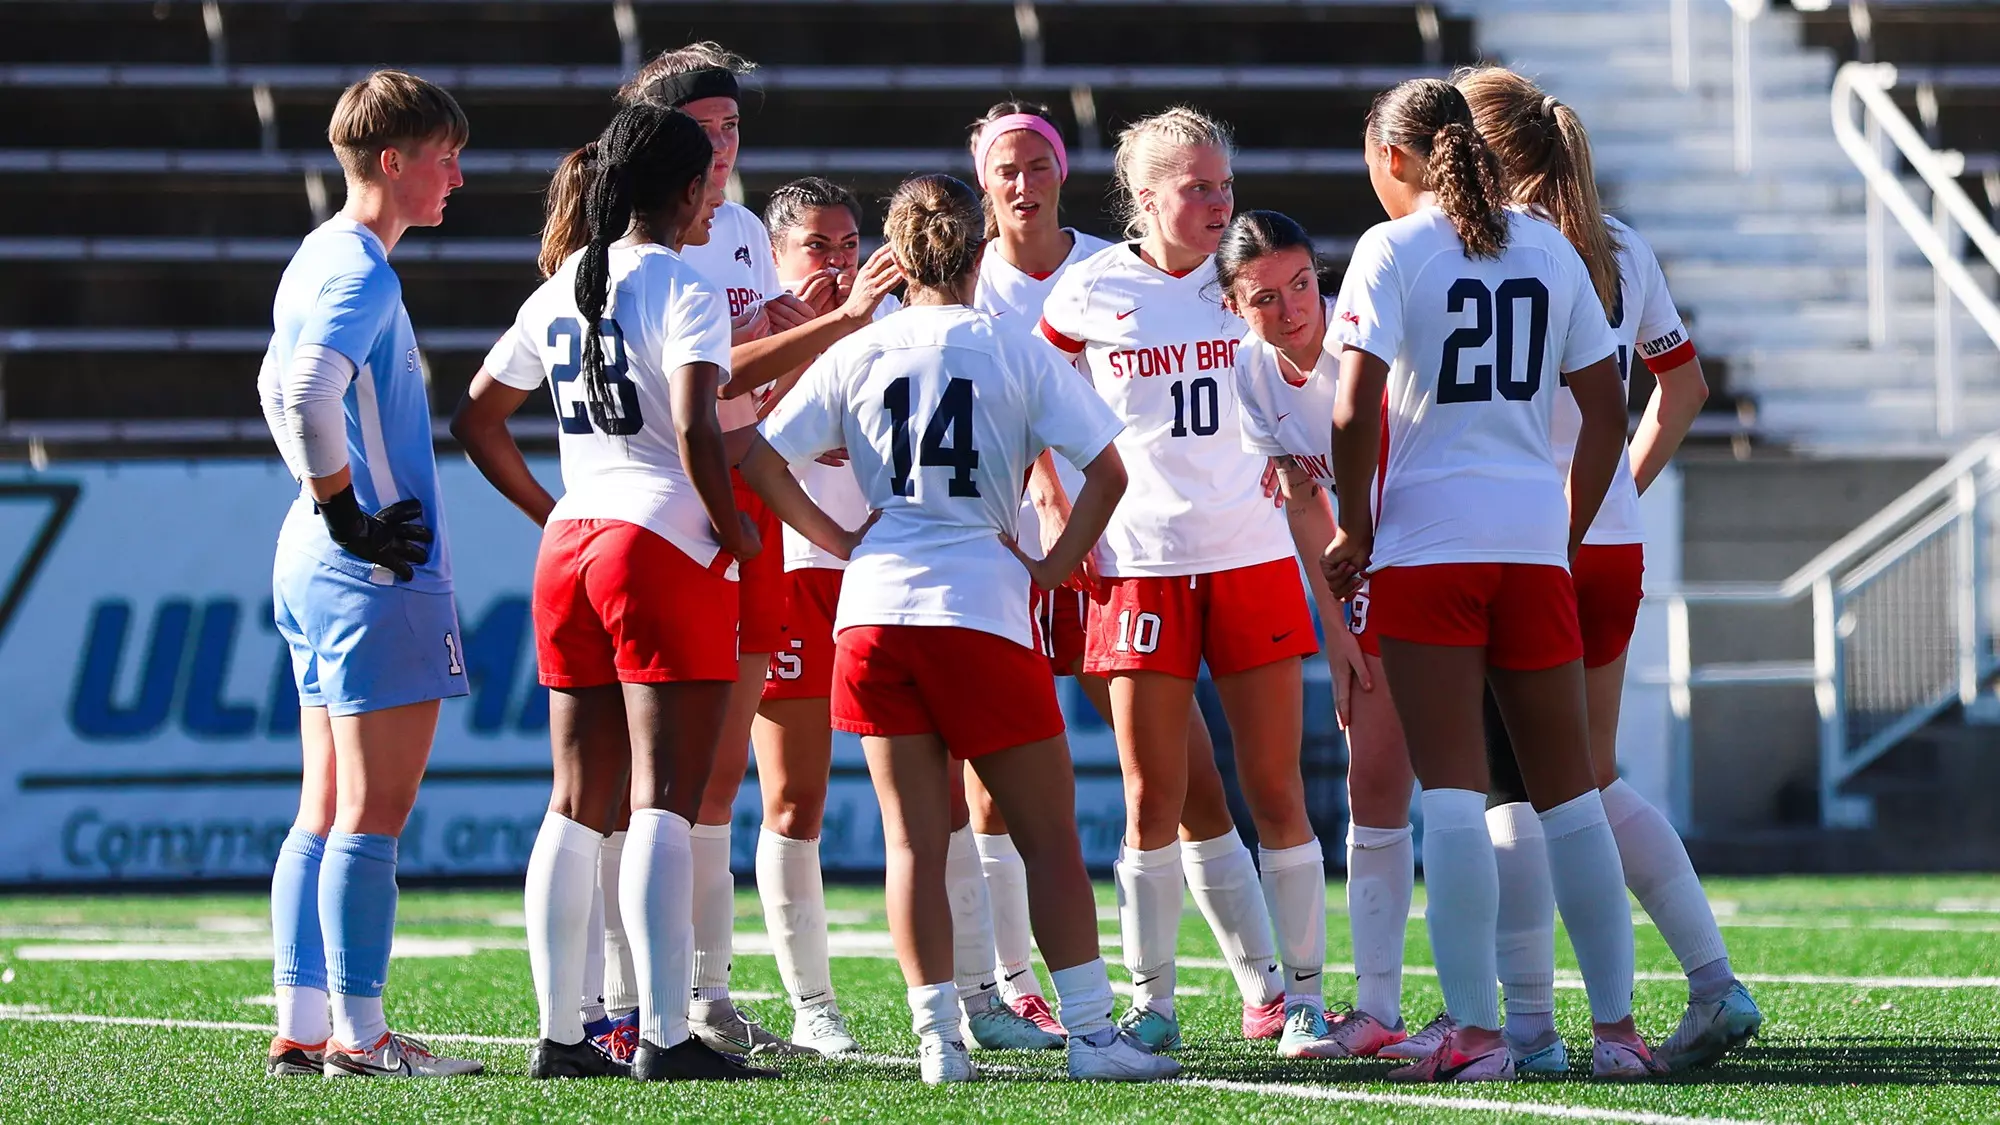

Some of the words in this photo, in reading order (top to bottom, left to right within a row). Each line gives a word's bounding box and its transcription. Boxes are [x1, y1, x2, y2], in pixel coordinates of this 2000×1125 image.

[1108, 343, 1187, 378] STONY
[1437, 277, 1550, 404] 20
[1642, 328, 1683, 356] CAPTAIN
[1170, 377, 1219, 437] 10
[883, 376, 980, 498] 14
[443, 632, 462, 676] 1
[1115, 609, 1162, 654] 10
